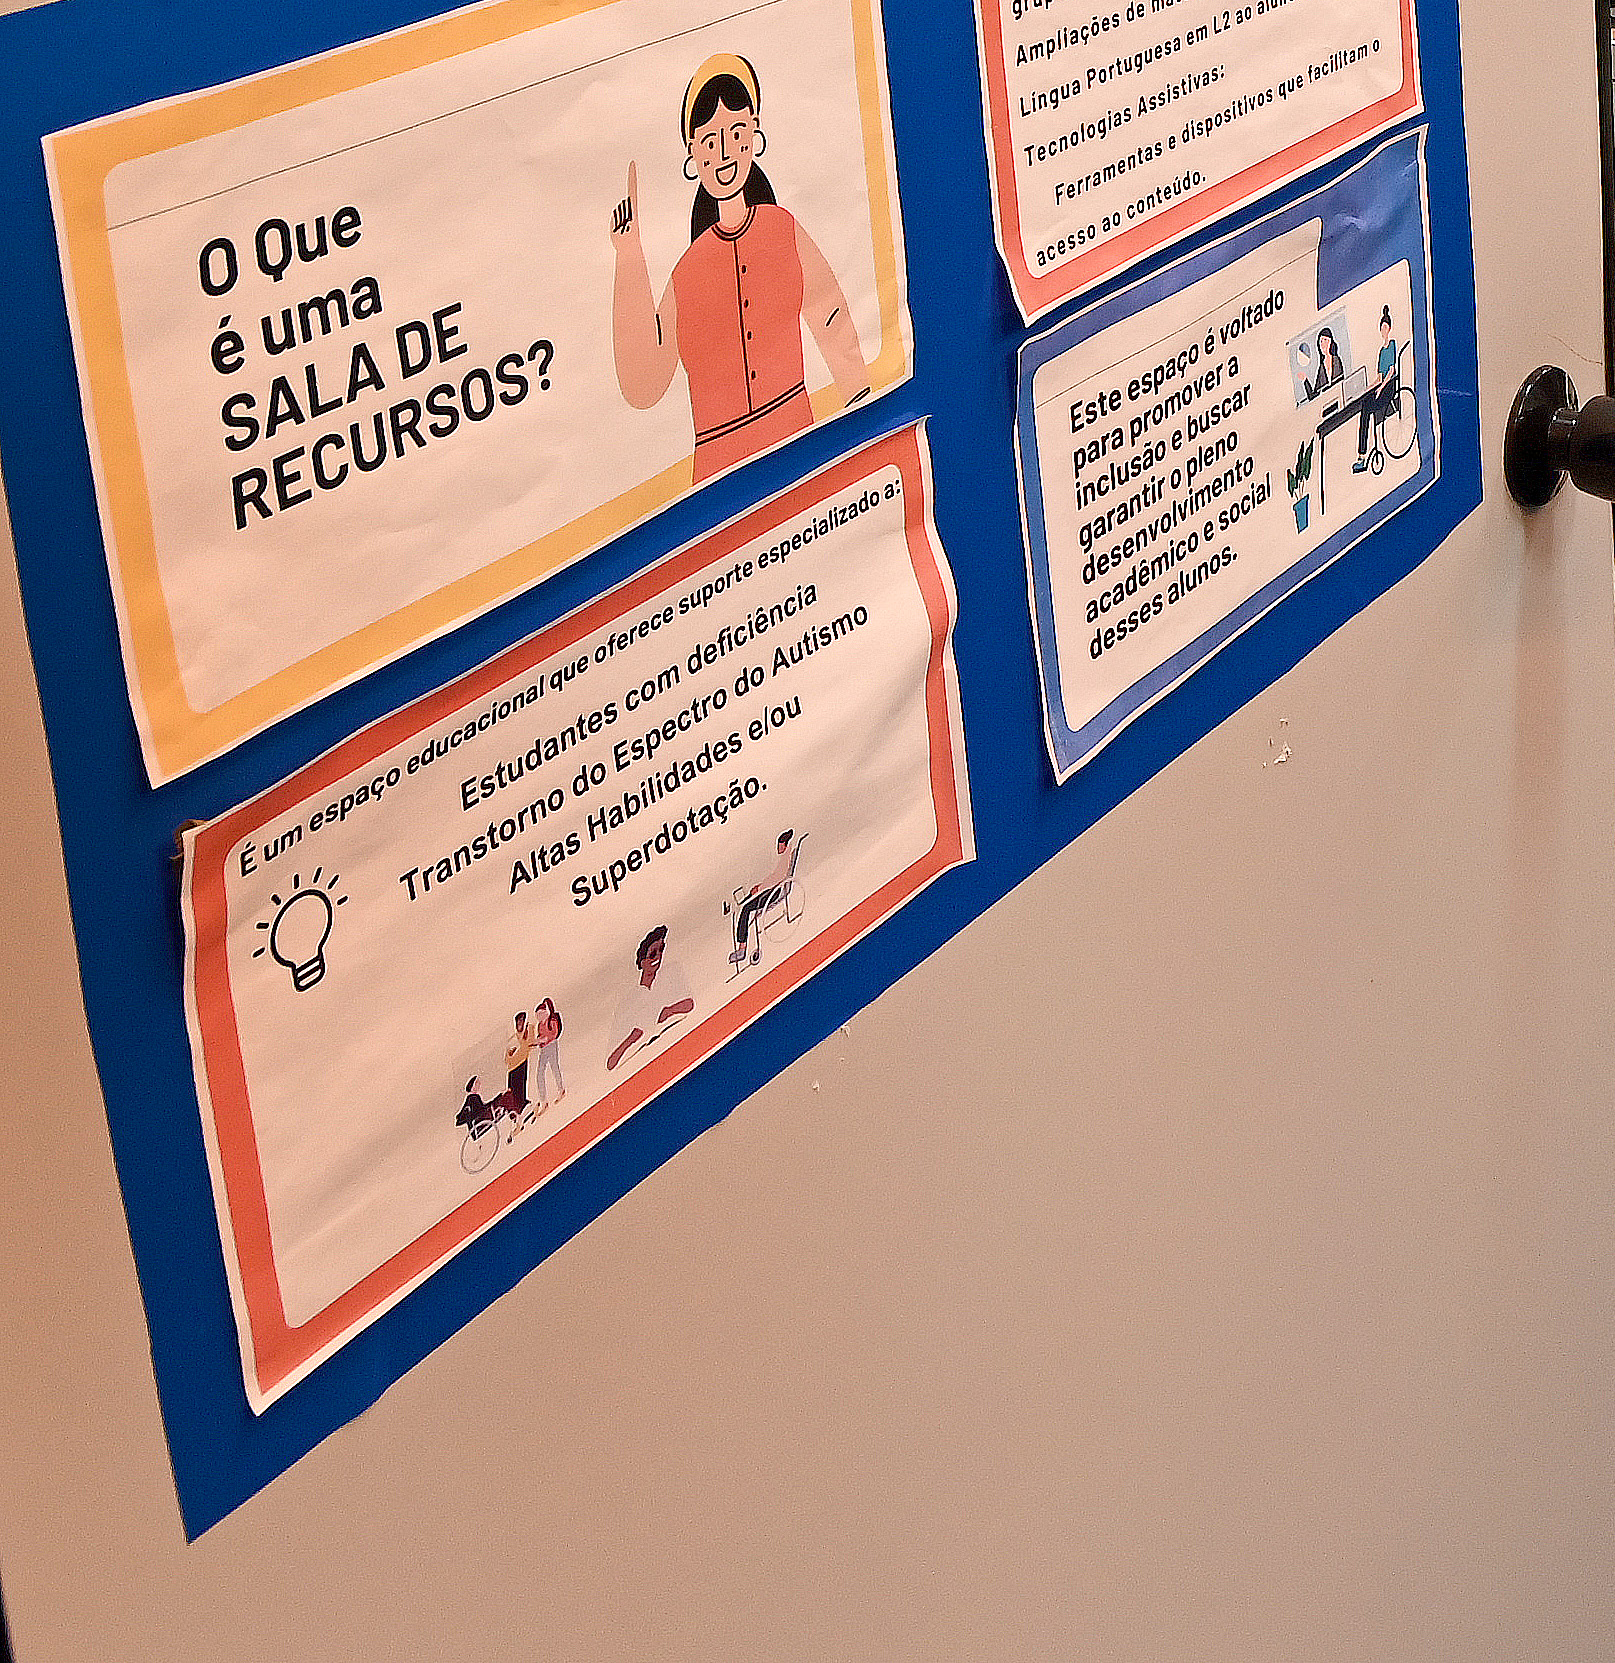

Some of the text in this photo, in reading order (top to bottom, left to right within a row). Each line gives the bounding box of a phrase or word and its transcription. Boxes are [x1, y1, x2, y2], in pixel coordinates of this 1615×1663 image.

[1017, 14, 1119, 67] Ampliações
[1127, 1, 1144, 22] de
[1020, 80, 1080, 117] Língua
[1087, 37, 1180, 89] Portuguesa
[1187, 25, 1207, 45] em
[1214, 11, 1230, 34] L2
[1236, 7, 1251, 24] ao
[1024, 65, 1224, 166] Tecnologias Assistivas:
[1055, 40, 1379, 205] Ferramentas e dispositivos que facilitam o
[199, 207, 361, 296] O Que
[1037, 171, 1205, 266] acesso ao conteúdo.
[211, 277, 382, 374] é uma
[222, 302, 468, 451] SALA DE
[1070, 290, 1283, 433] Este espaço é voltado
[232, 340, 553, 530] RECURSOS?
[1074, 356, 1238, 479] para promover a
[1076, 384, 1250, 510] inclusão e buscar
[1080, 431, 1238, 554] garantir o pleno
[1083, 457, 1255, 584] desenvolvimento
[1086, 472, 1270, 623] acadêmico e social
[1090, 546, 1237, 659] desses alunos.
[240, 478, 900, 877] É um espaço educacional que oferece suporte especializado a:
[461, 585, 817, 811] Estudantes com deficiência
[400, 607, 867, 901] Transtorno do Espectro do Autismo
[510, 696, 801, 895] Altas Habilidades e/ou
[572, 778, 766, 906] Superdotação.
